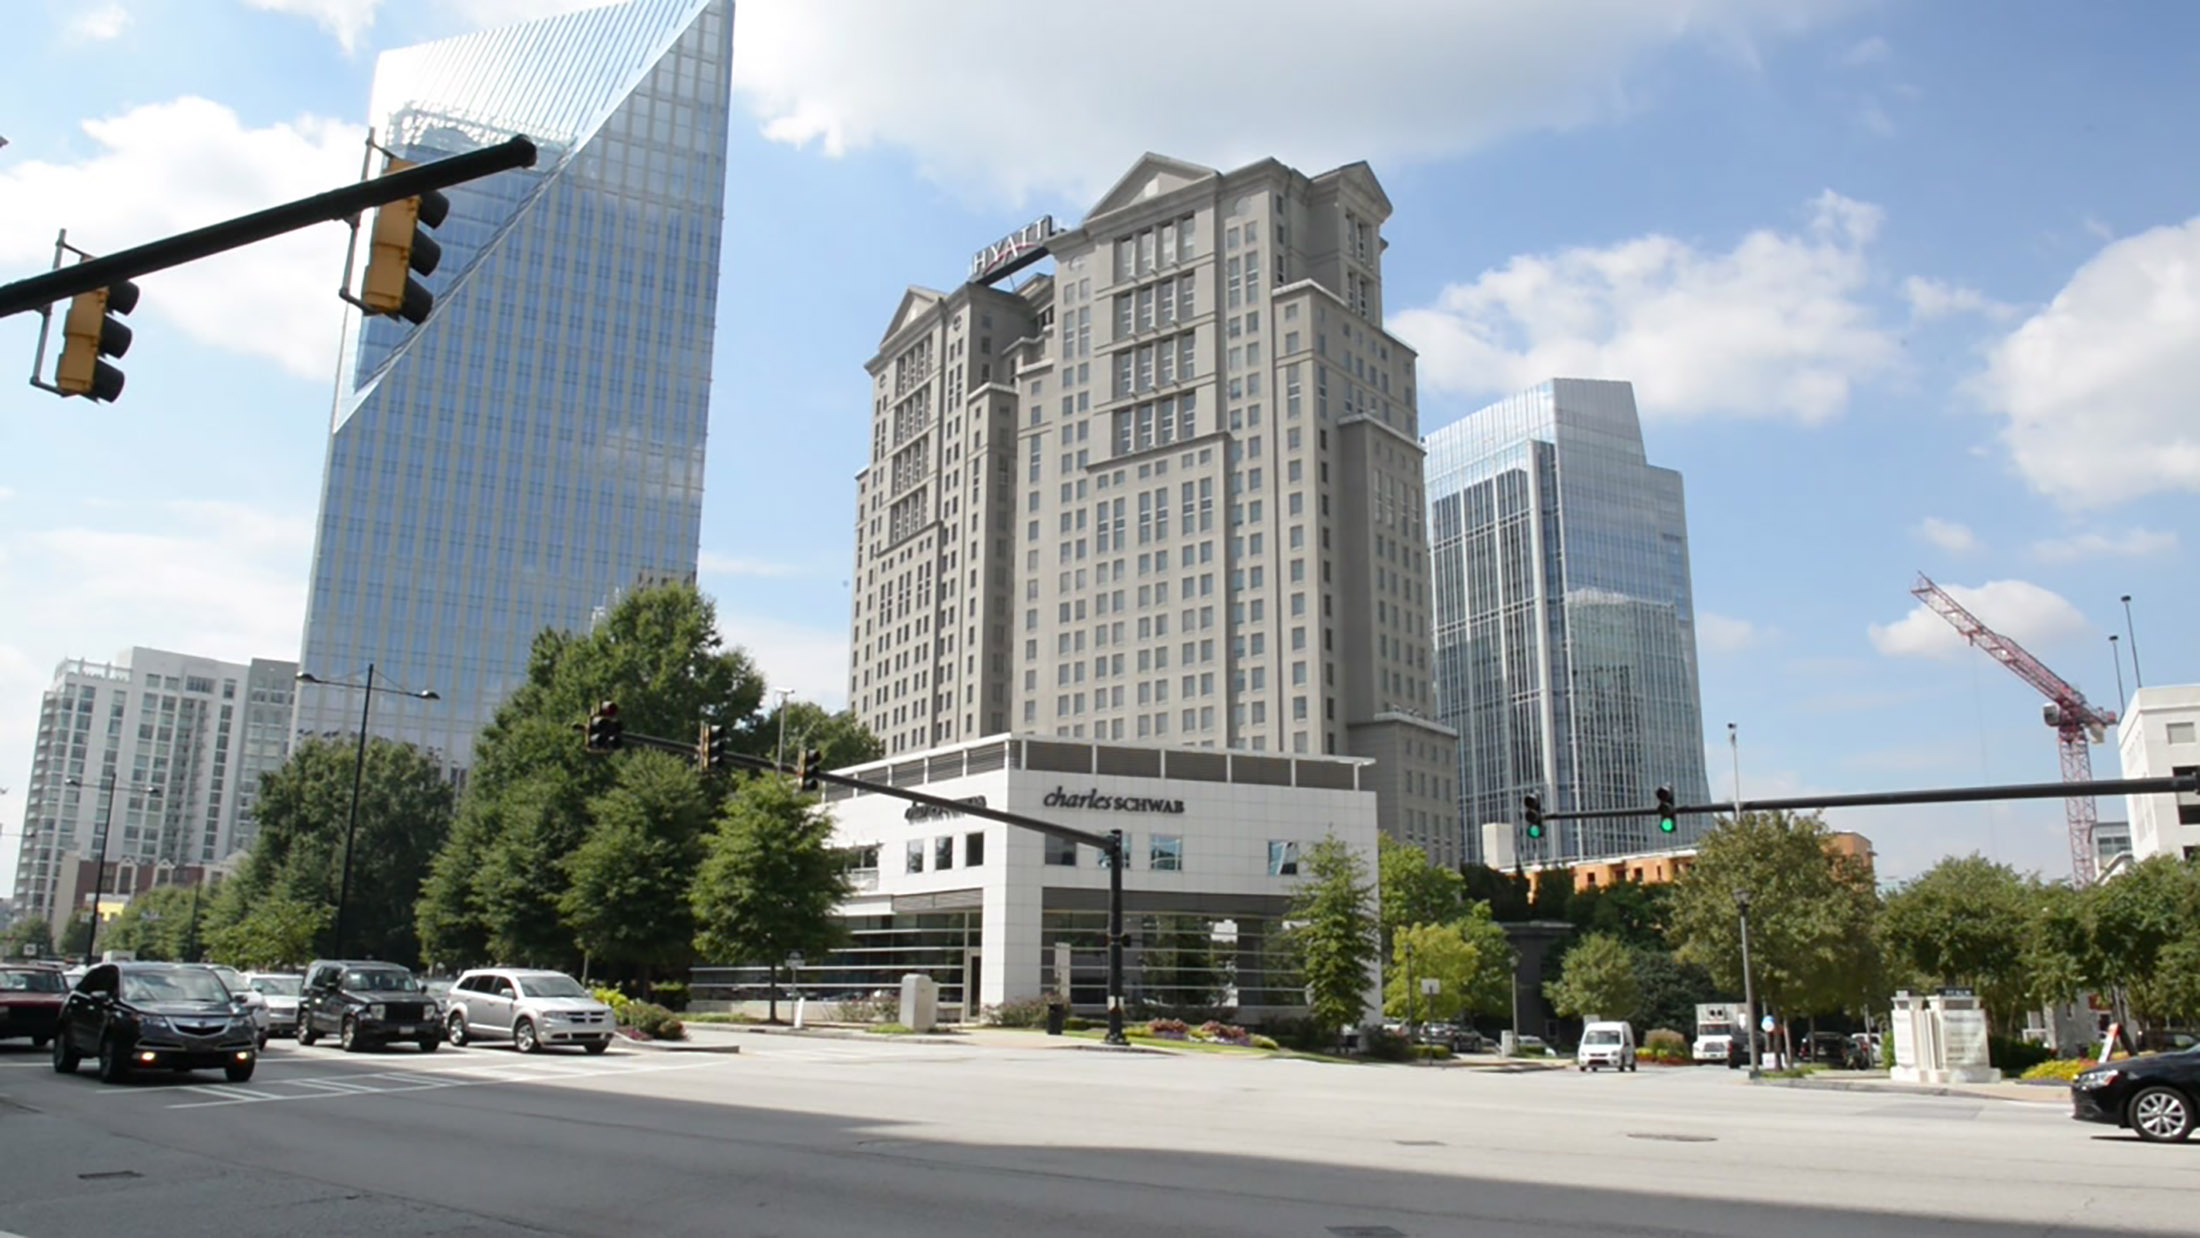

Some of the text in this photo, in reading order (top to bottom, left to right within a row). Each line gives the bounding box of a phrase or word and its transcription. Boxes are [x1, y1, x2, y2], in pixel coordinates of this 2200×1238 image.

[973, 217, 1047, 274] HYATT
[1043, 785, 1185, 814] charles SCHWAB
